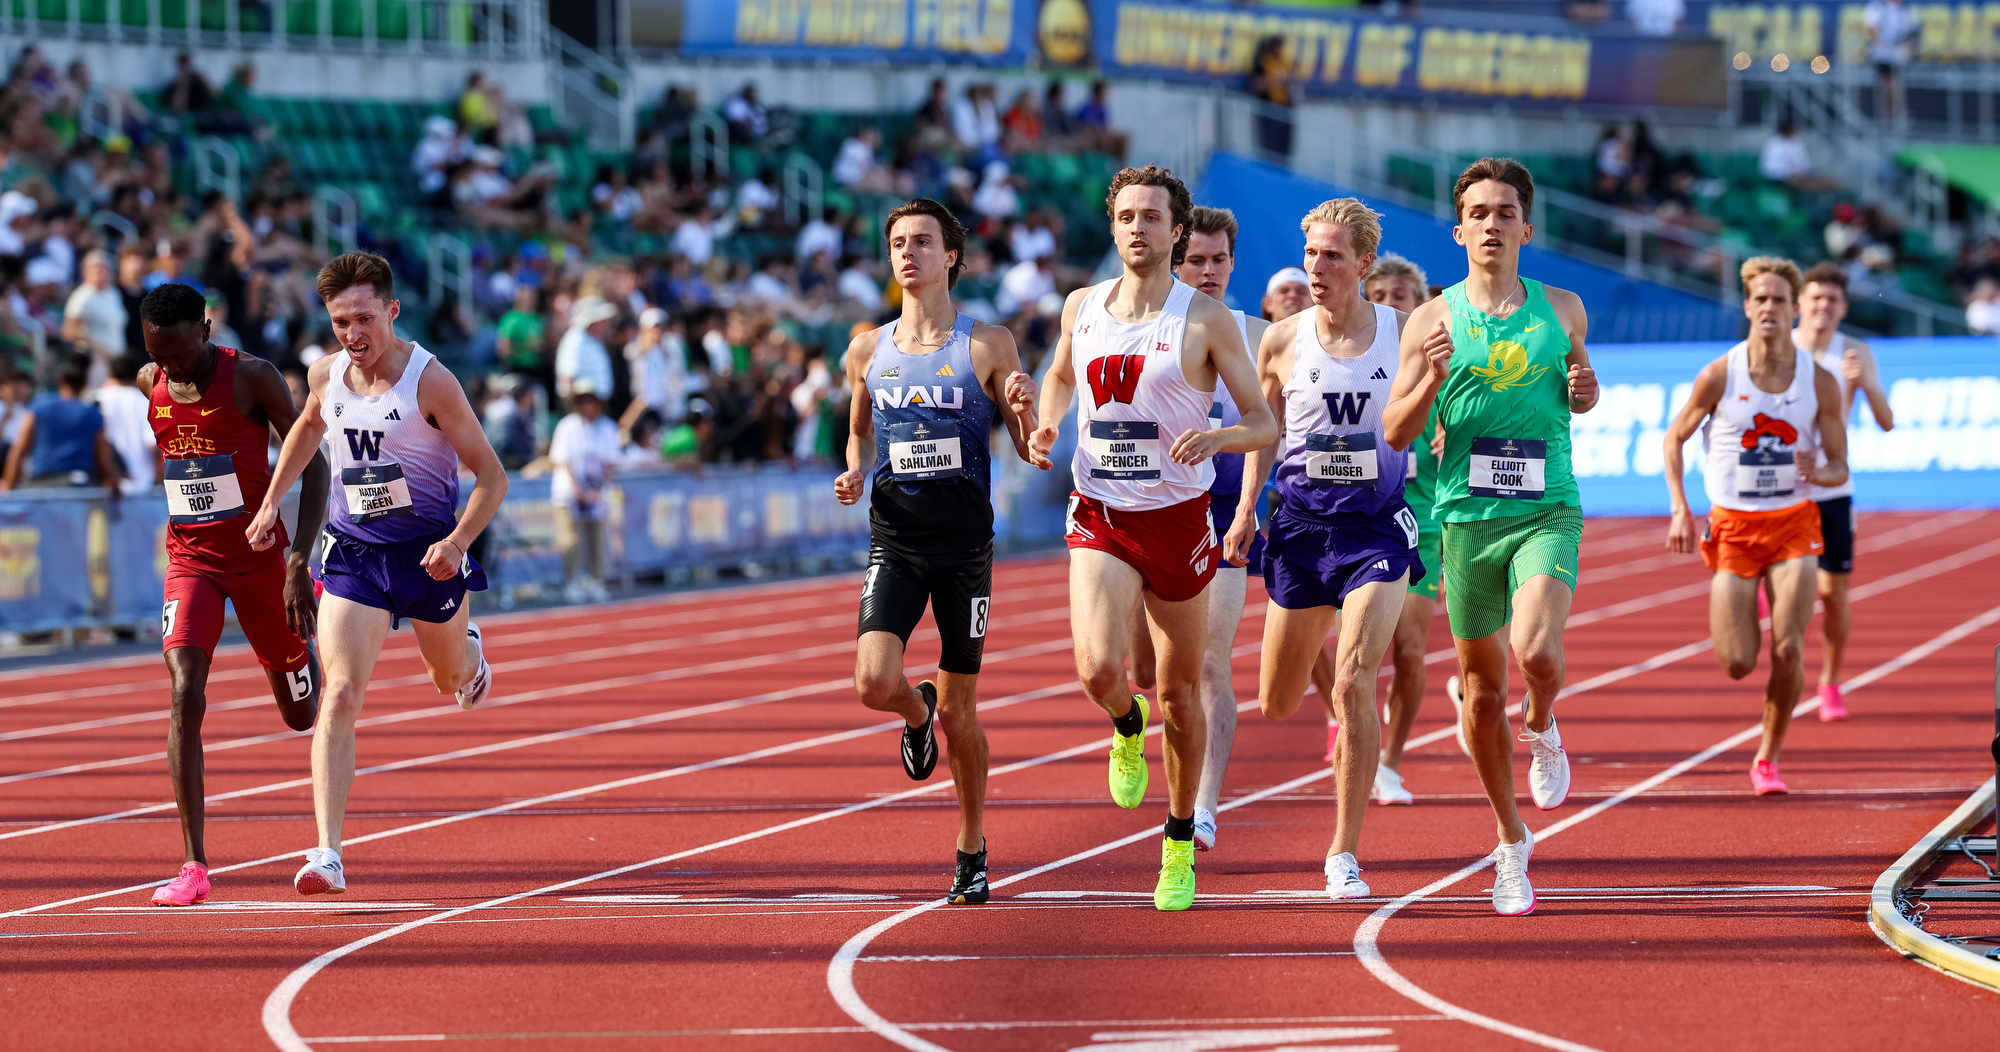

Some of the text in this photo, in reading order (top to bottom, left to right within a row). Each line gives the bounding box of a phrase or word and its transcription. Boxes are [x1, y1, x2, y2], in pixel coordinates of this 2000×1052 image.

[1087, 354, 1146, 411] W
[873, 385, 964, 411] NAU
[1322, 391, 1371, 426] W
[168, 436, 216, 454] STATE
[344, 427, 385, 462] W
[911, 443, 937, 455] COLIN
[1109, 442, 1136, 453] ADAM
[900, 454, 952, 470] SAHLMAN
[1101, 454, 1149, 468] SPENCER
[1330, 454, 1352, 464] LUKE
[1491, 459, 1527, 472] ELLIOTT
[1321, 465, 1363, 477] HOUSER
[1492, 472, 1523, 487] COOK
[180, 481, 218, 496] EZEKIEL
[359, 485, 390, 497] NATHAN
[188, 495, 214, 512] ROP
[362, 496, 393, 511] GREEN
[1401, 510, 1417, 545] 9
[1194, 555, 1210, 577] W
[976, 599, 987, 635] 8
[293, 670, 310, 698] 5
